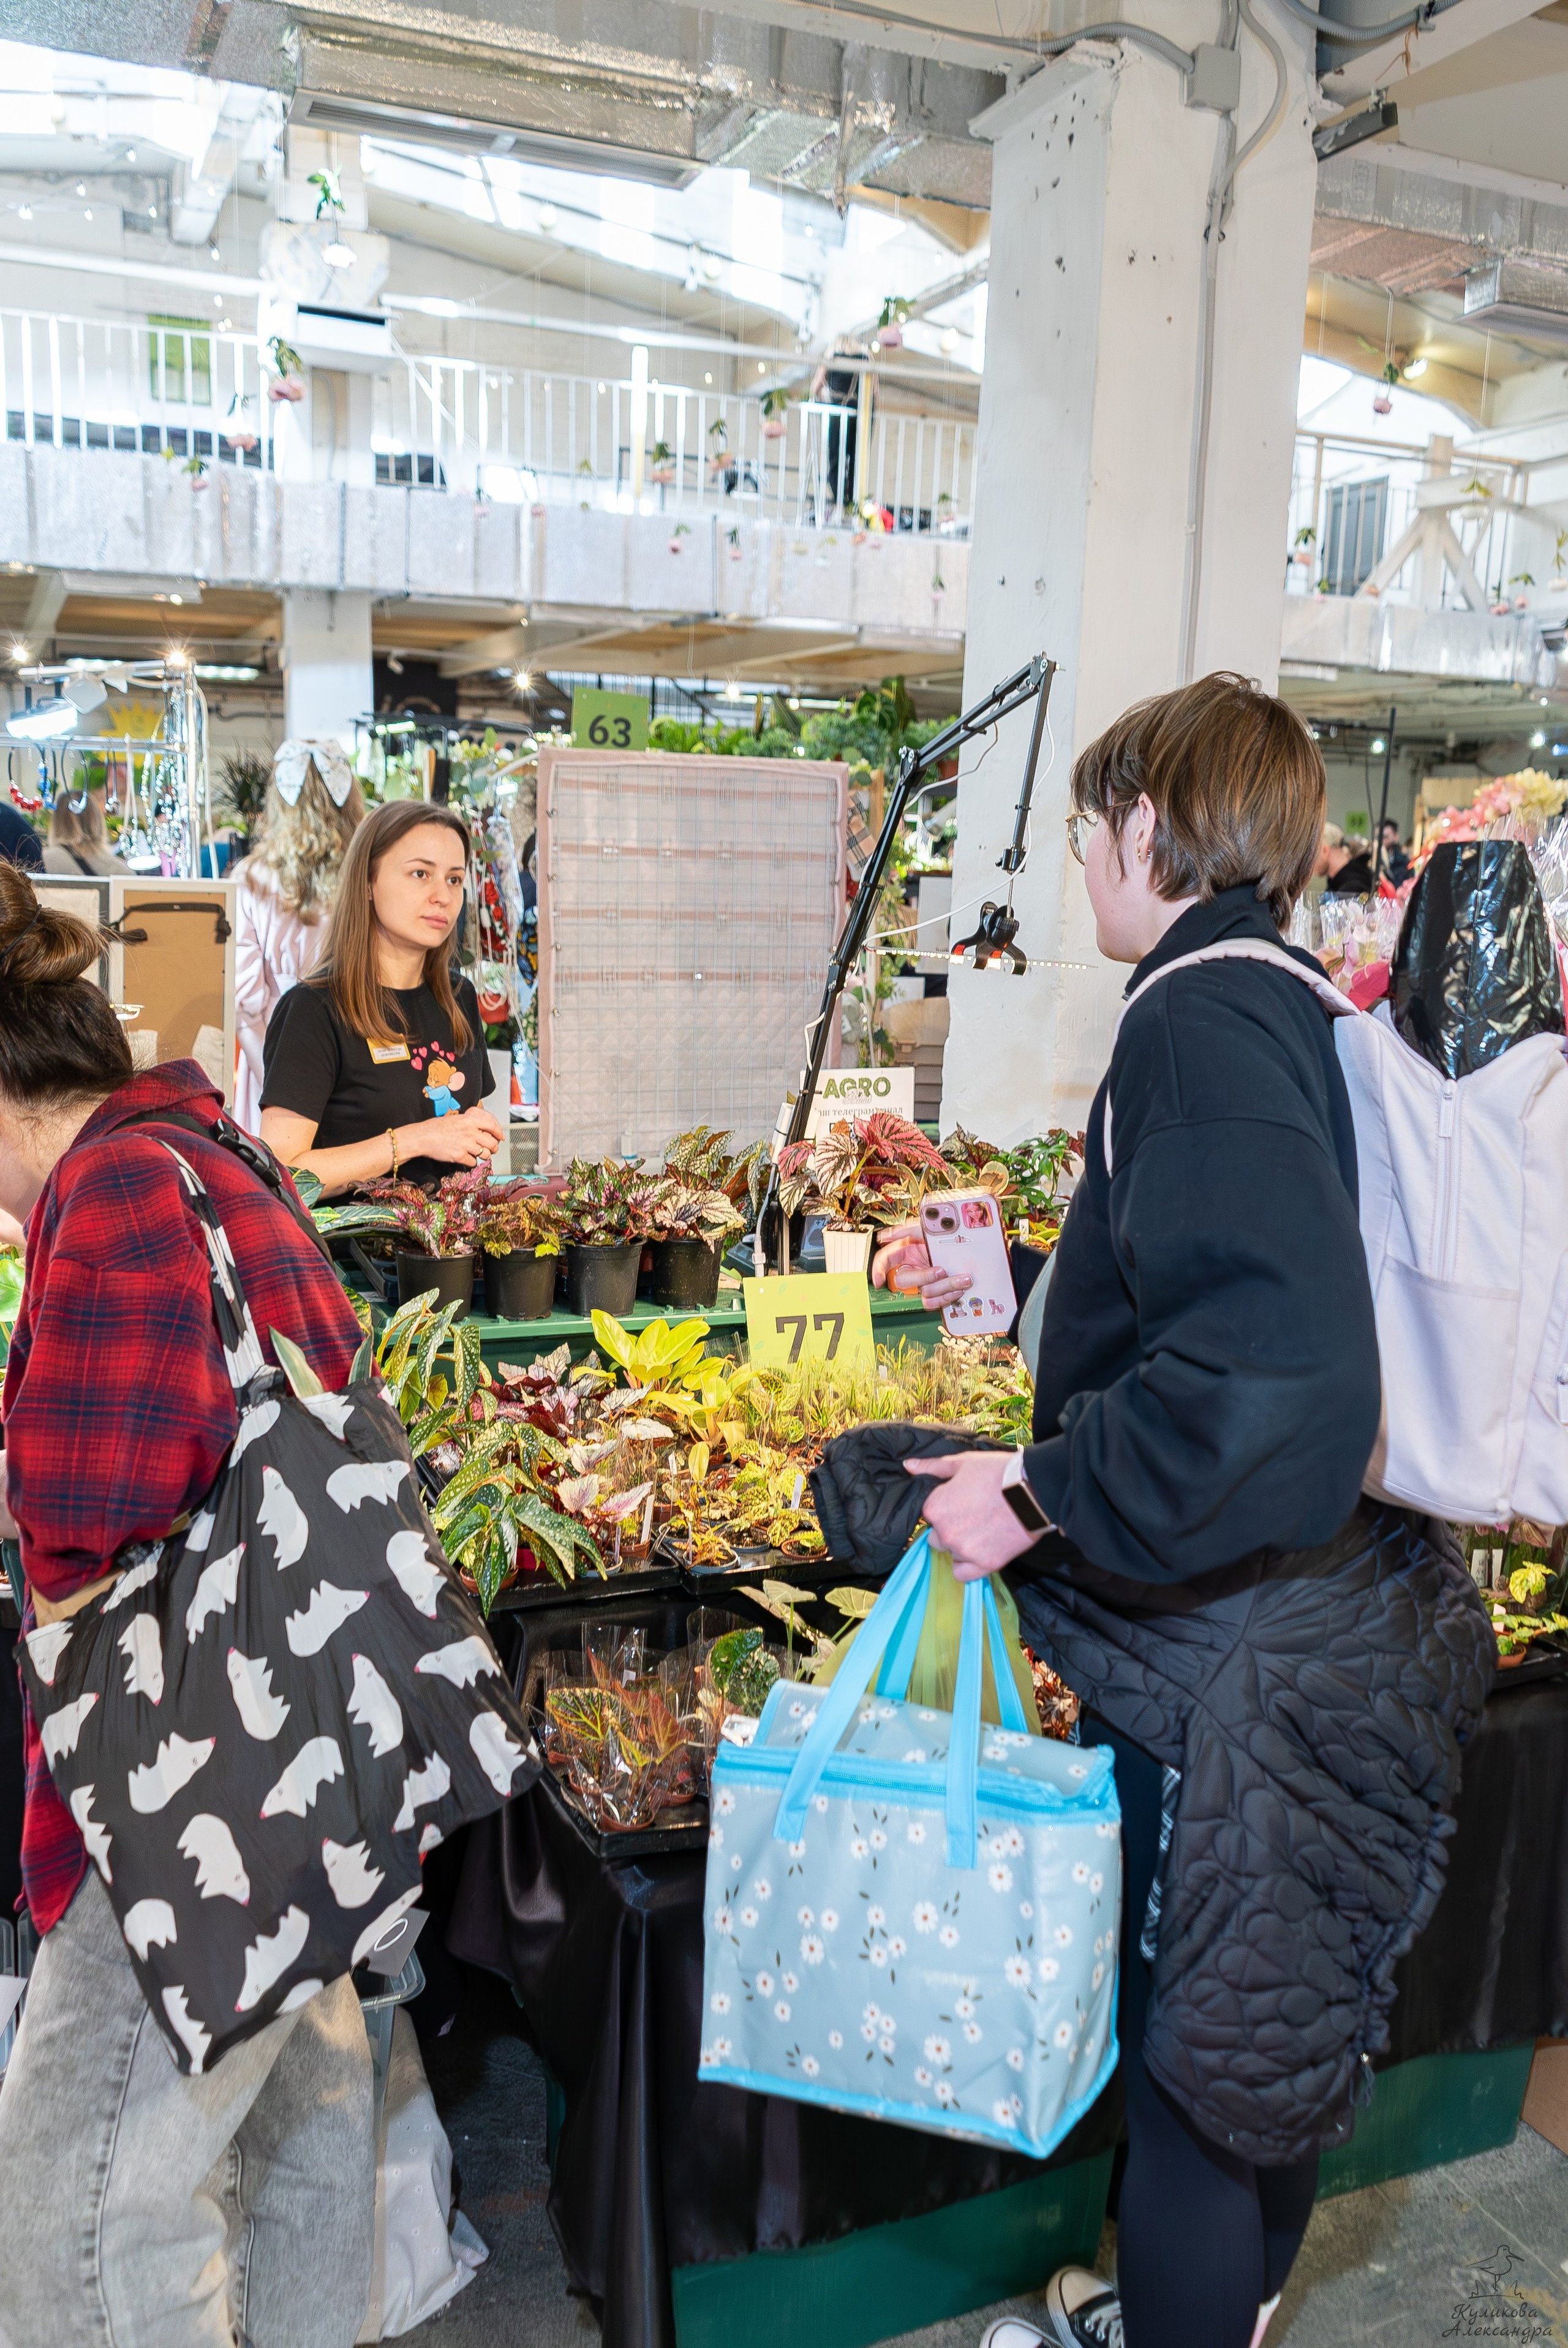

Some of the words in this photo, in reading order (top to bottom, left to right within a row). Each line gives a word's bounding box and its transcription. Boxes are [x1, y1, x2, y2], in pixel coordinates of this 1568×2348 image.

[589, 714, 631, 748] 63
[823, 1077, 891, 1099] AGRO
[775, 1312, 845, 1364] 77
